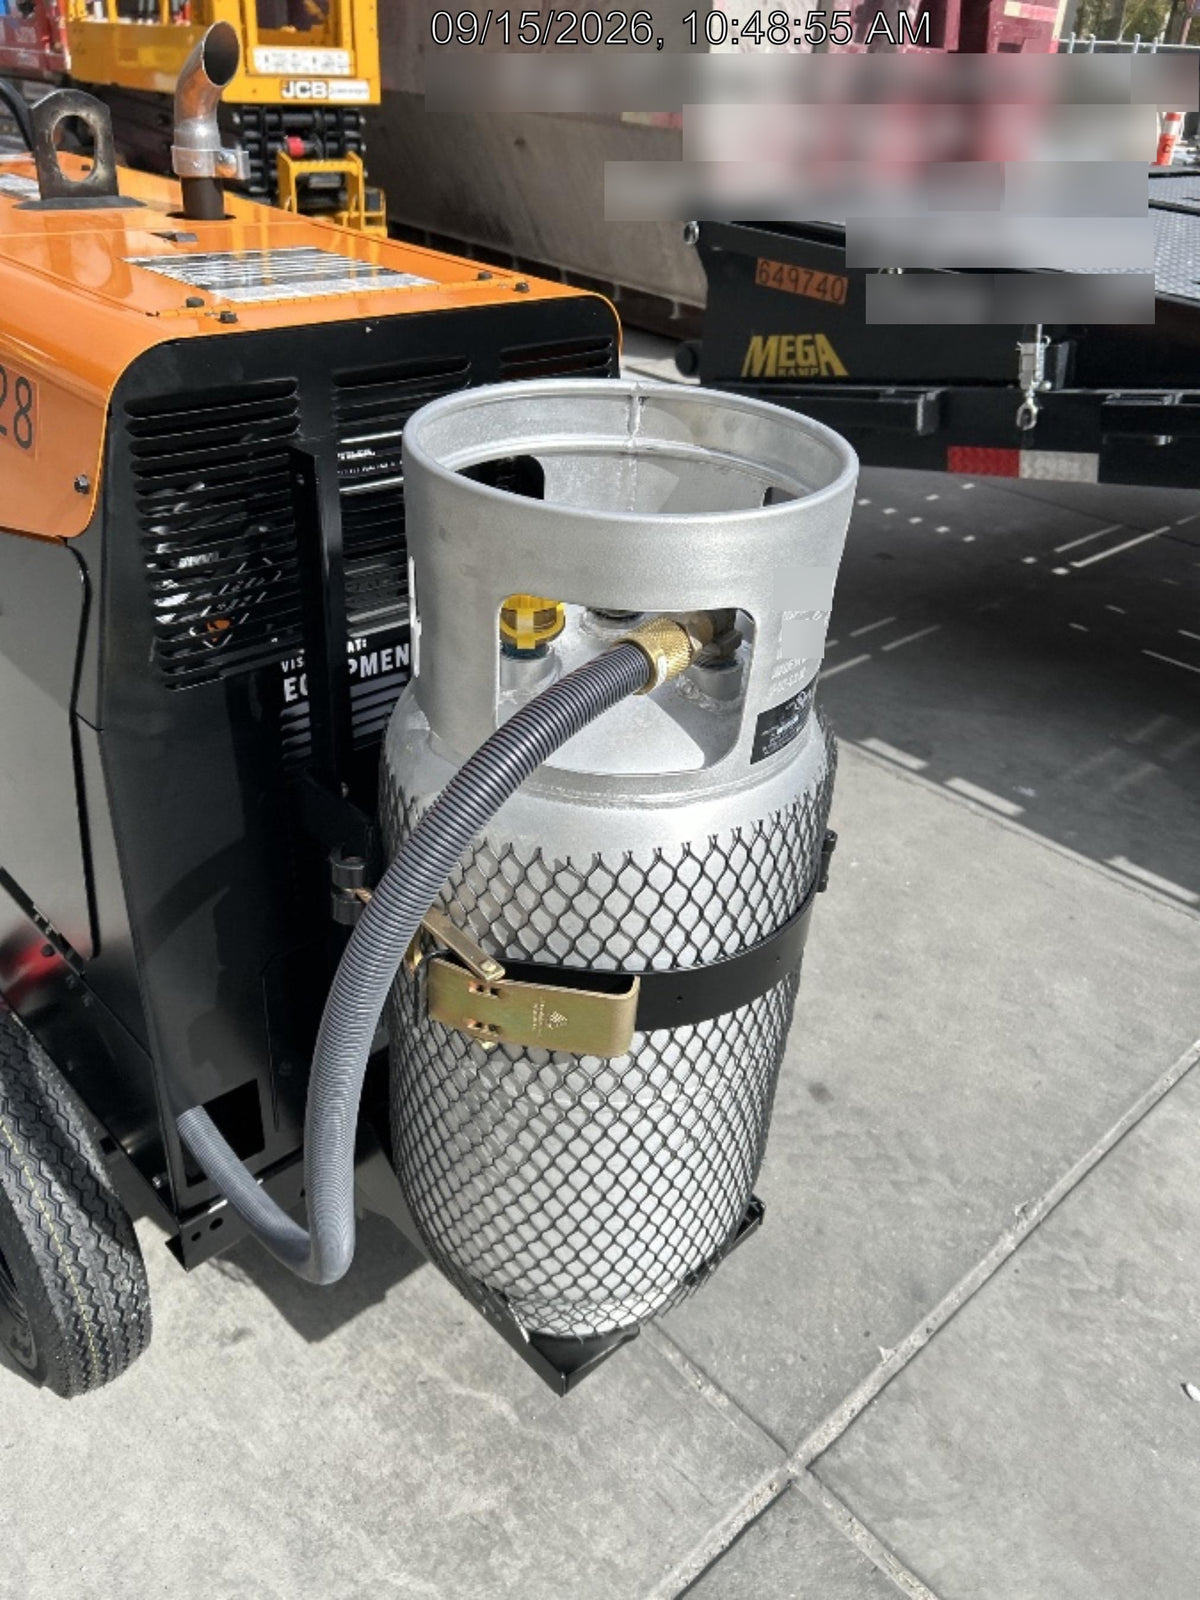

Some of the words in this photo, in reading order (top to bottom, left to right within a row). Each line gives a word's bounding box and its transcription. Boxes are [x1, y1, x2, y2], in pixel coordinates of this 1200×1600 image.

[280, 80, 328, 99] JCB
[757, 260, 845, 302] 649740
[741, 333, 849, 377] MEGA
